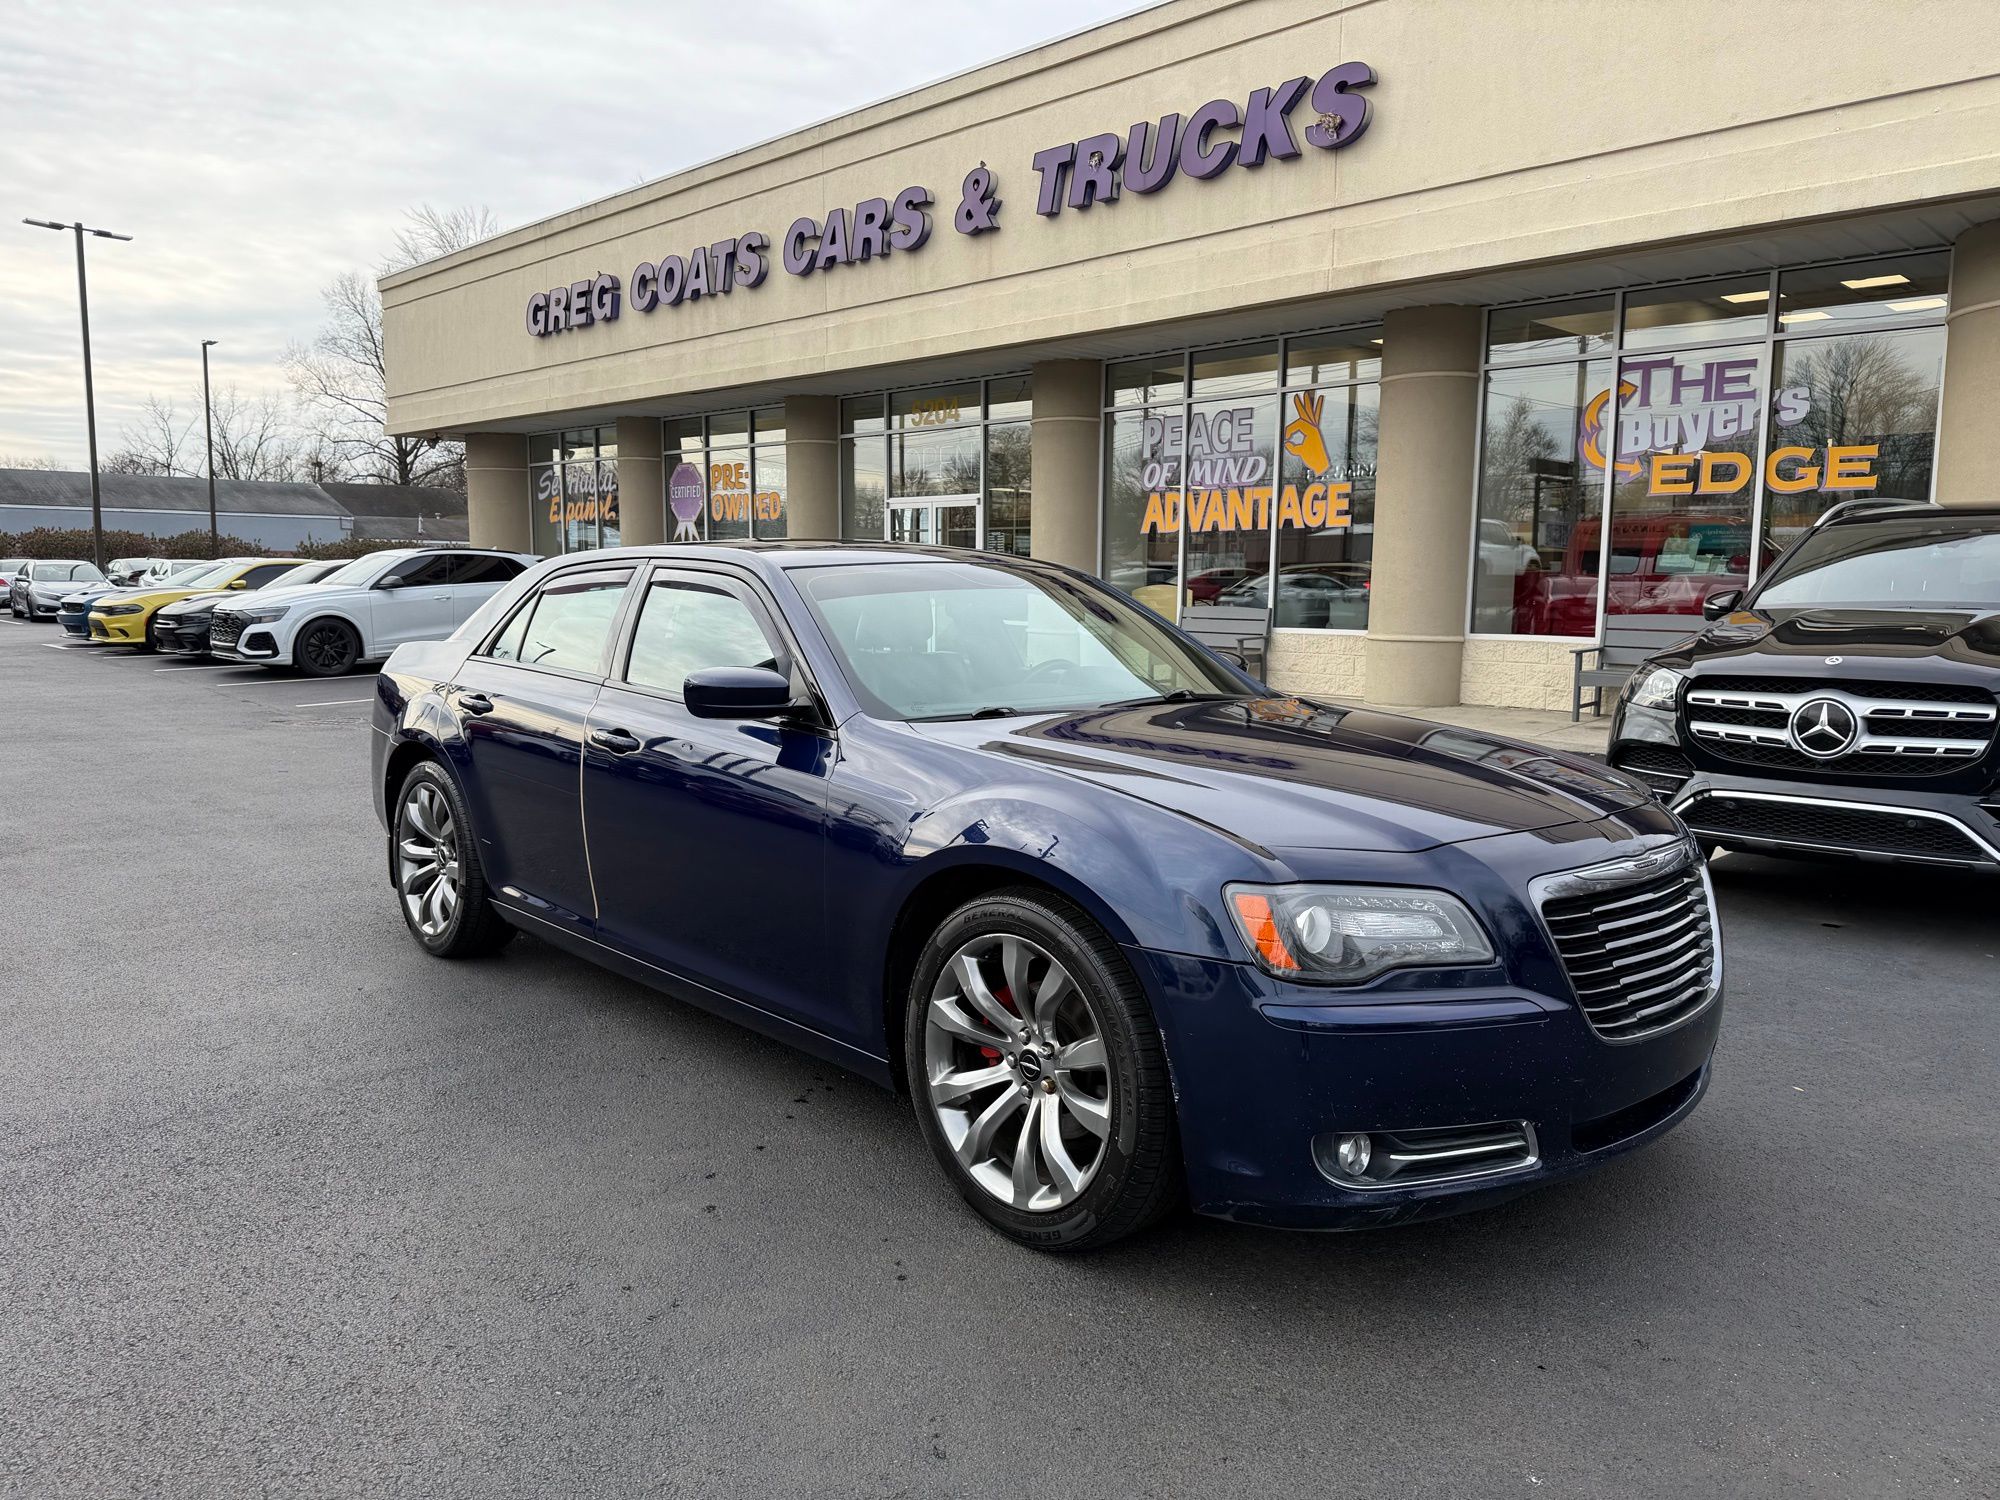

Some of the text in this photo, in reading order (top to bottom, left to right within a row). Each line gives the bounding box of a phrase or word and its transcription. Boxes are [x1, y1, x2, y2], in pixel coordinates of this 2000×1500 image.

[526, 61, 1378, 337] GREG COATS CARS & TRUCKS
[1618, 356, 1758, 407] THE
[911, 397, 961, 427] 5204
[1143, 407, 1254, 459] PEACE
[1616, 386, 1811, 455] Buyer's
[538, 469, 560, 500] Se
[671, 485, 701, 499] CERTIFIED
[1142, 456, 1267, 491] OF MIND
[1648, 443, 1880, 496] EDGE
[711, 491, 781, 521] OWNED
[1140, 481, 1353, 534] ADVANTAGE
